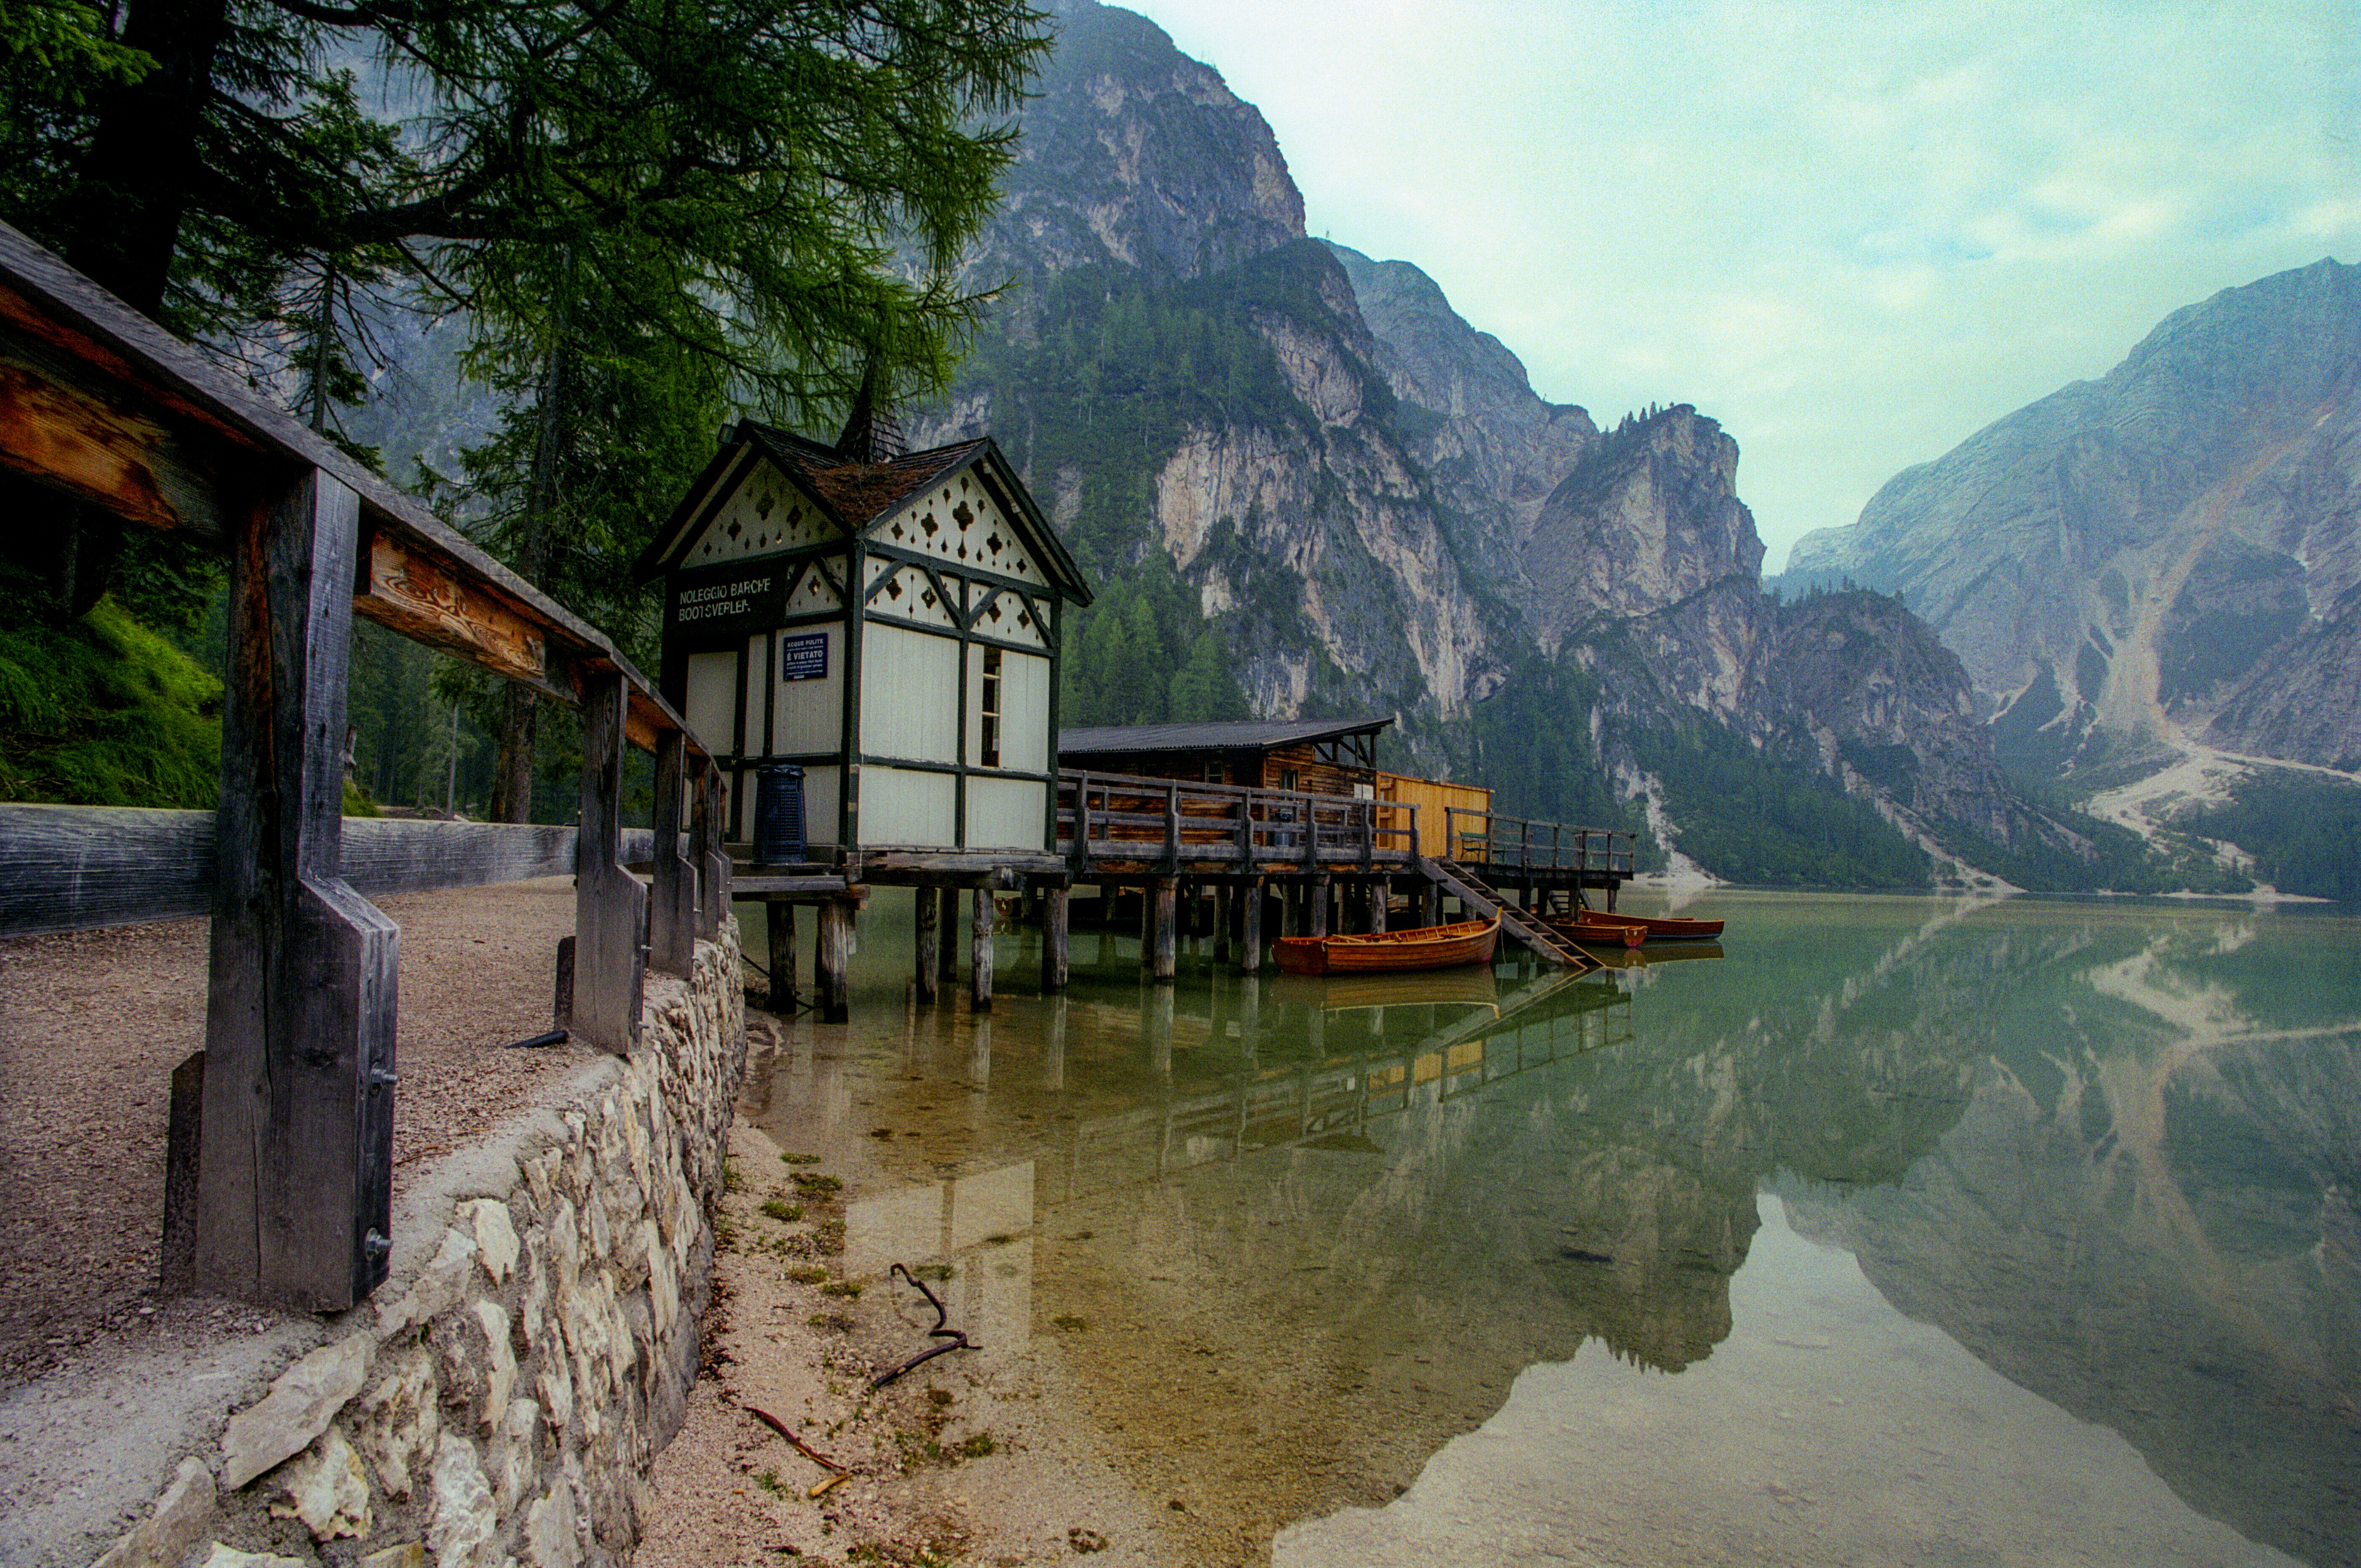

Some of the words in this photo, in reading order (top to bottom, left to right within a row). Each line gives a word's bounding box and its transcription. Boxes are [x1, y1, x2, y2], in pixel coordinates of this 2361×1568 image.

[680, 585, 727, 605] NOLEGGIO
[731, 578, 771, 596] BARCHE
[787, 652, 791, 661] È
[793, 650, 823, 660] VIETATO
